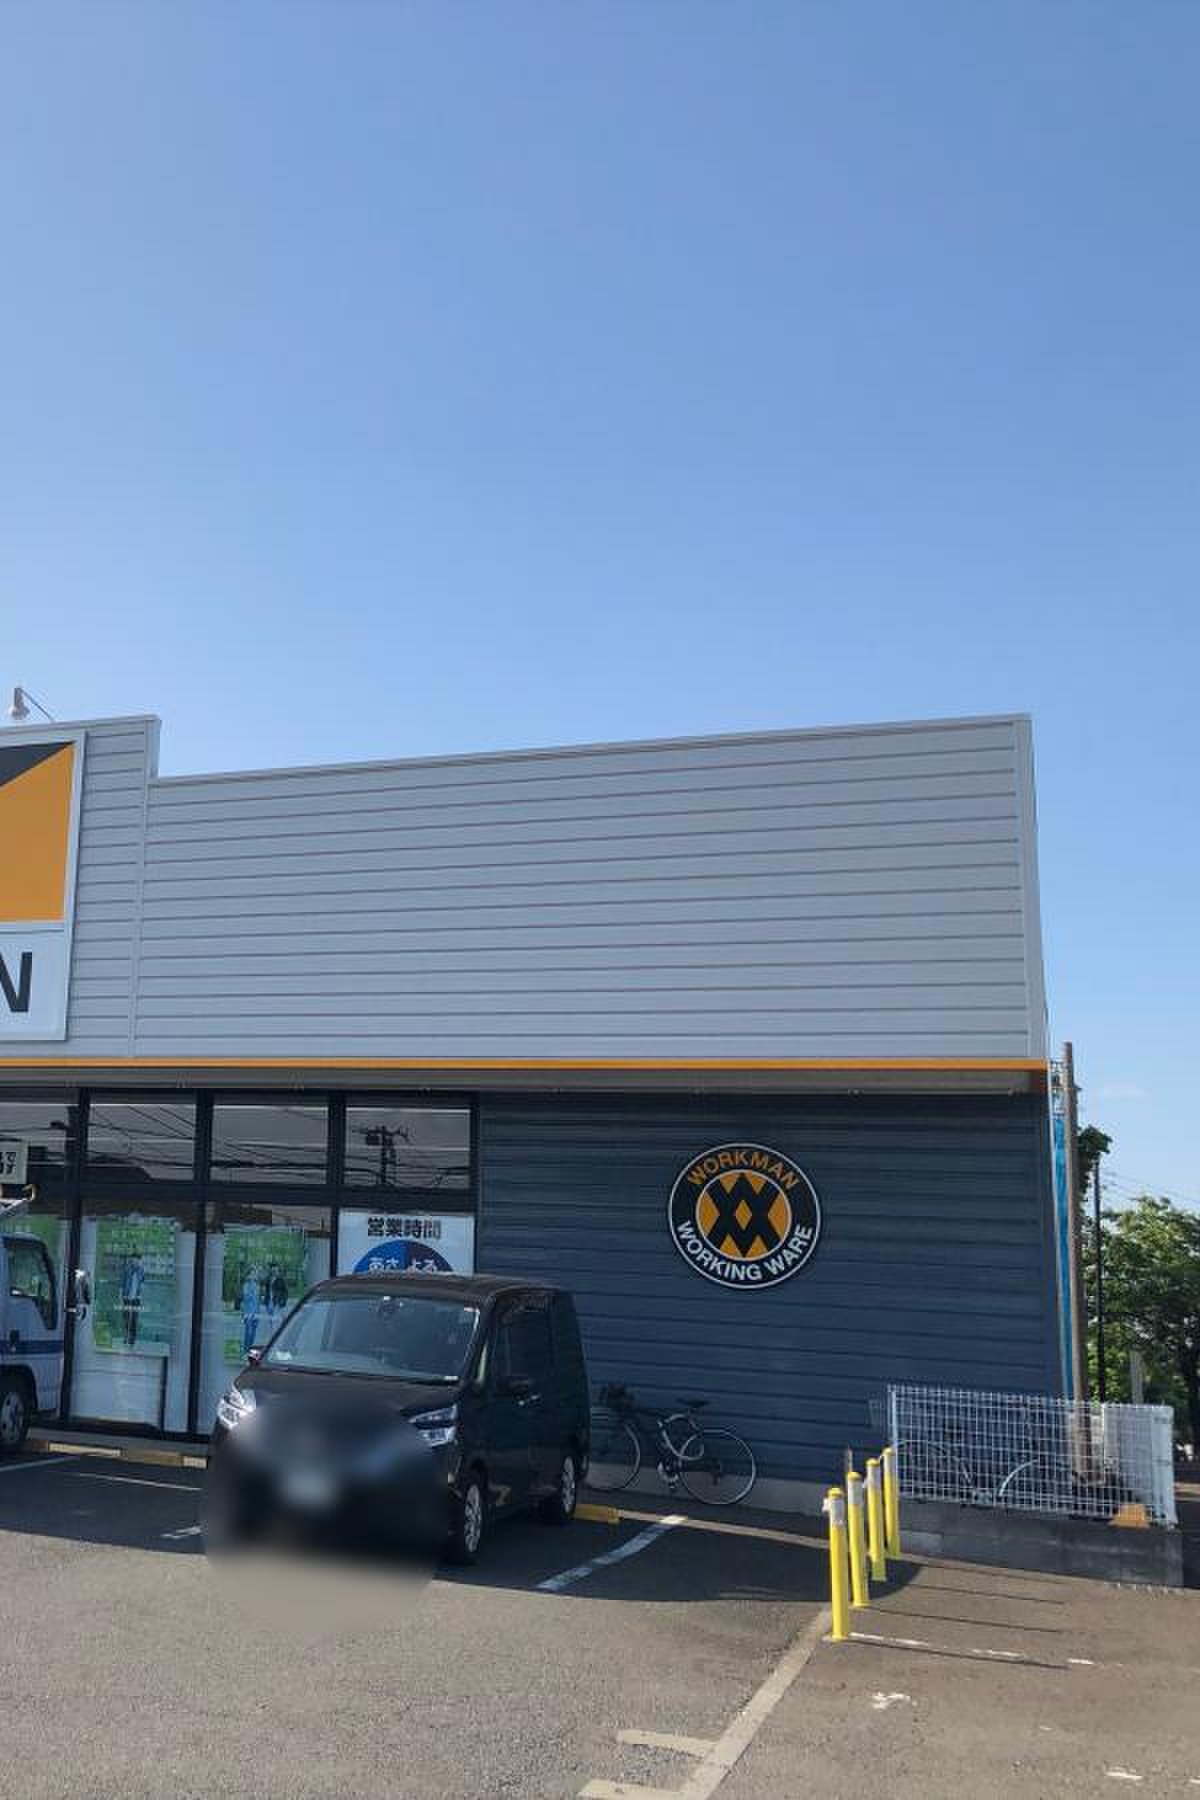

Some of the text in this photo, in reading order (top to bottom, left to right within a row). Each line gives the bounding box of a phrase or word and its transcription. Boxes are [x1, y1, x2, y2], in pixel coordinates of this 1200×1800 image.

[687, 1151, 800, 1190] WORKMAN
[367, 1216, 442, 1240] 営業時間
[677, 1220, 814, 1281] WORKING WARE
